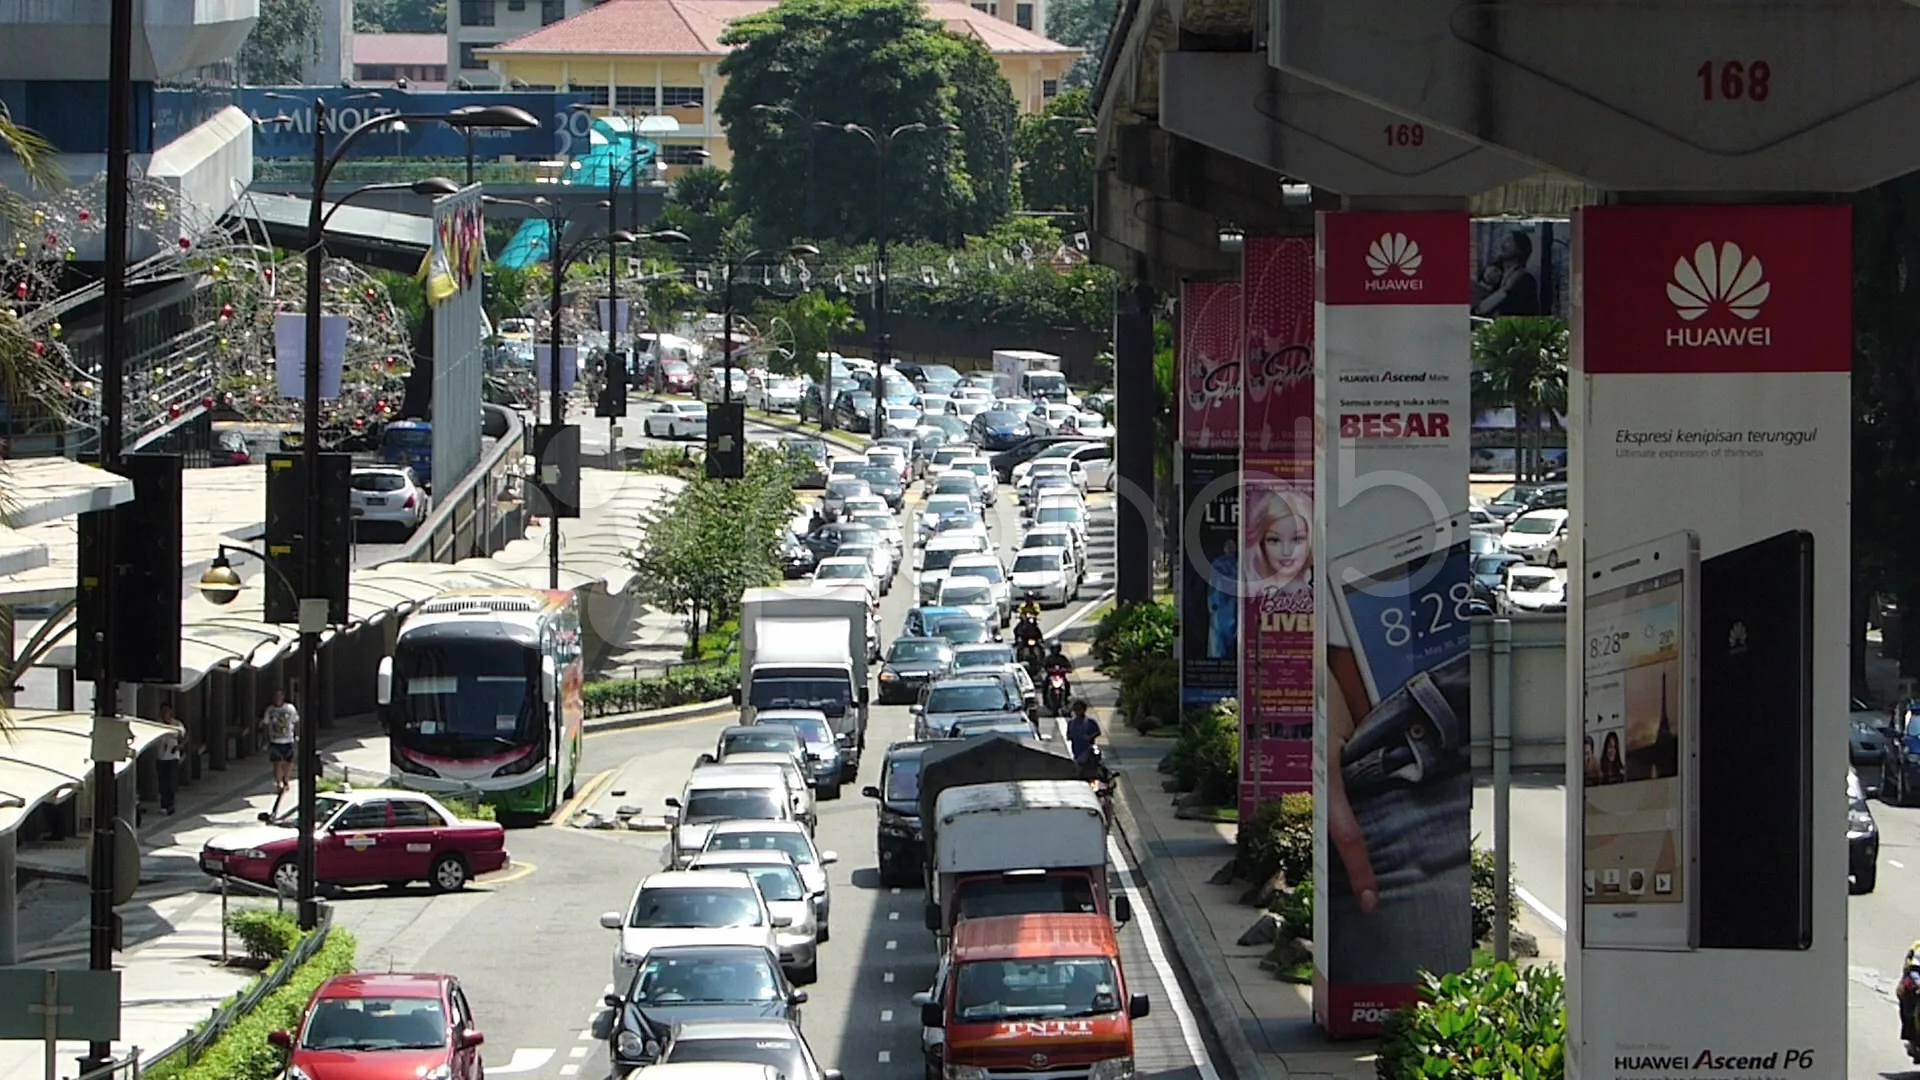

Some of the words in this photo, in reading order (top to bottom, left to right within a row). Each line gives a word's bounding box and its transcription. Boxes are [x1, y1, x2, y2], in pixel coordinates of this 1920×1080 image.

[1697, 60, 1771, 101] 168
[274, 107, 410, 134] MINOLTA
[1384, 124, 1425, 147] 169
[1364, 279, 1423, 291] HUAWEI
[1666, 327, 1772, 347] HUAWEI
[1380, 371, 1427, 382] Ascend
[1340, 399, 1370, 407] Semua
[1373, 400, 1400, 408] orang
[1403, 398, 1424, 406] suka
[1427, 398, 1449, 406] skrin
[1339, 412, 1450, 438] BESAR
[1615, 429, 1673, 445] Ekspresi
[1676, 428, 1742, 445] kenipisan
[1748, 427, 1818, 445] terunggul
[1380, 582, 1472, 647] 8:28
[1590, 631, 1621, 660] 8:28
[1615, 1056, 1689, 1070] HUAWEI
[1692, 1049, 1778, 1070] Ascend
[1783, 1049, 1815, 1070] P6
